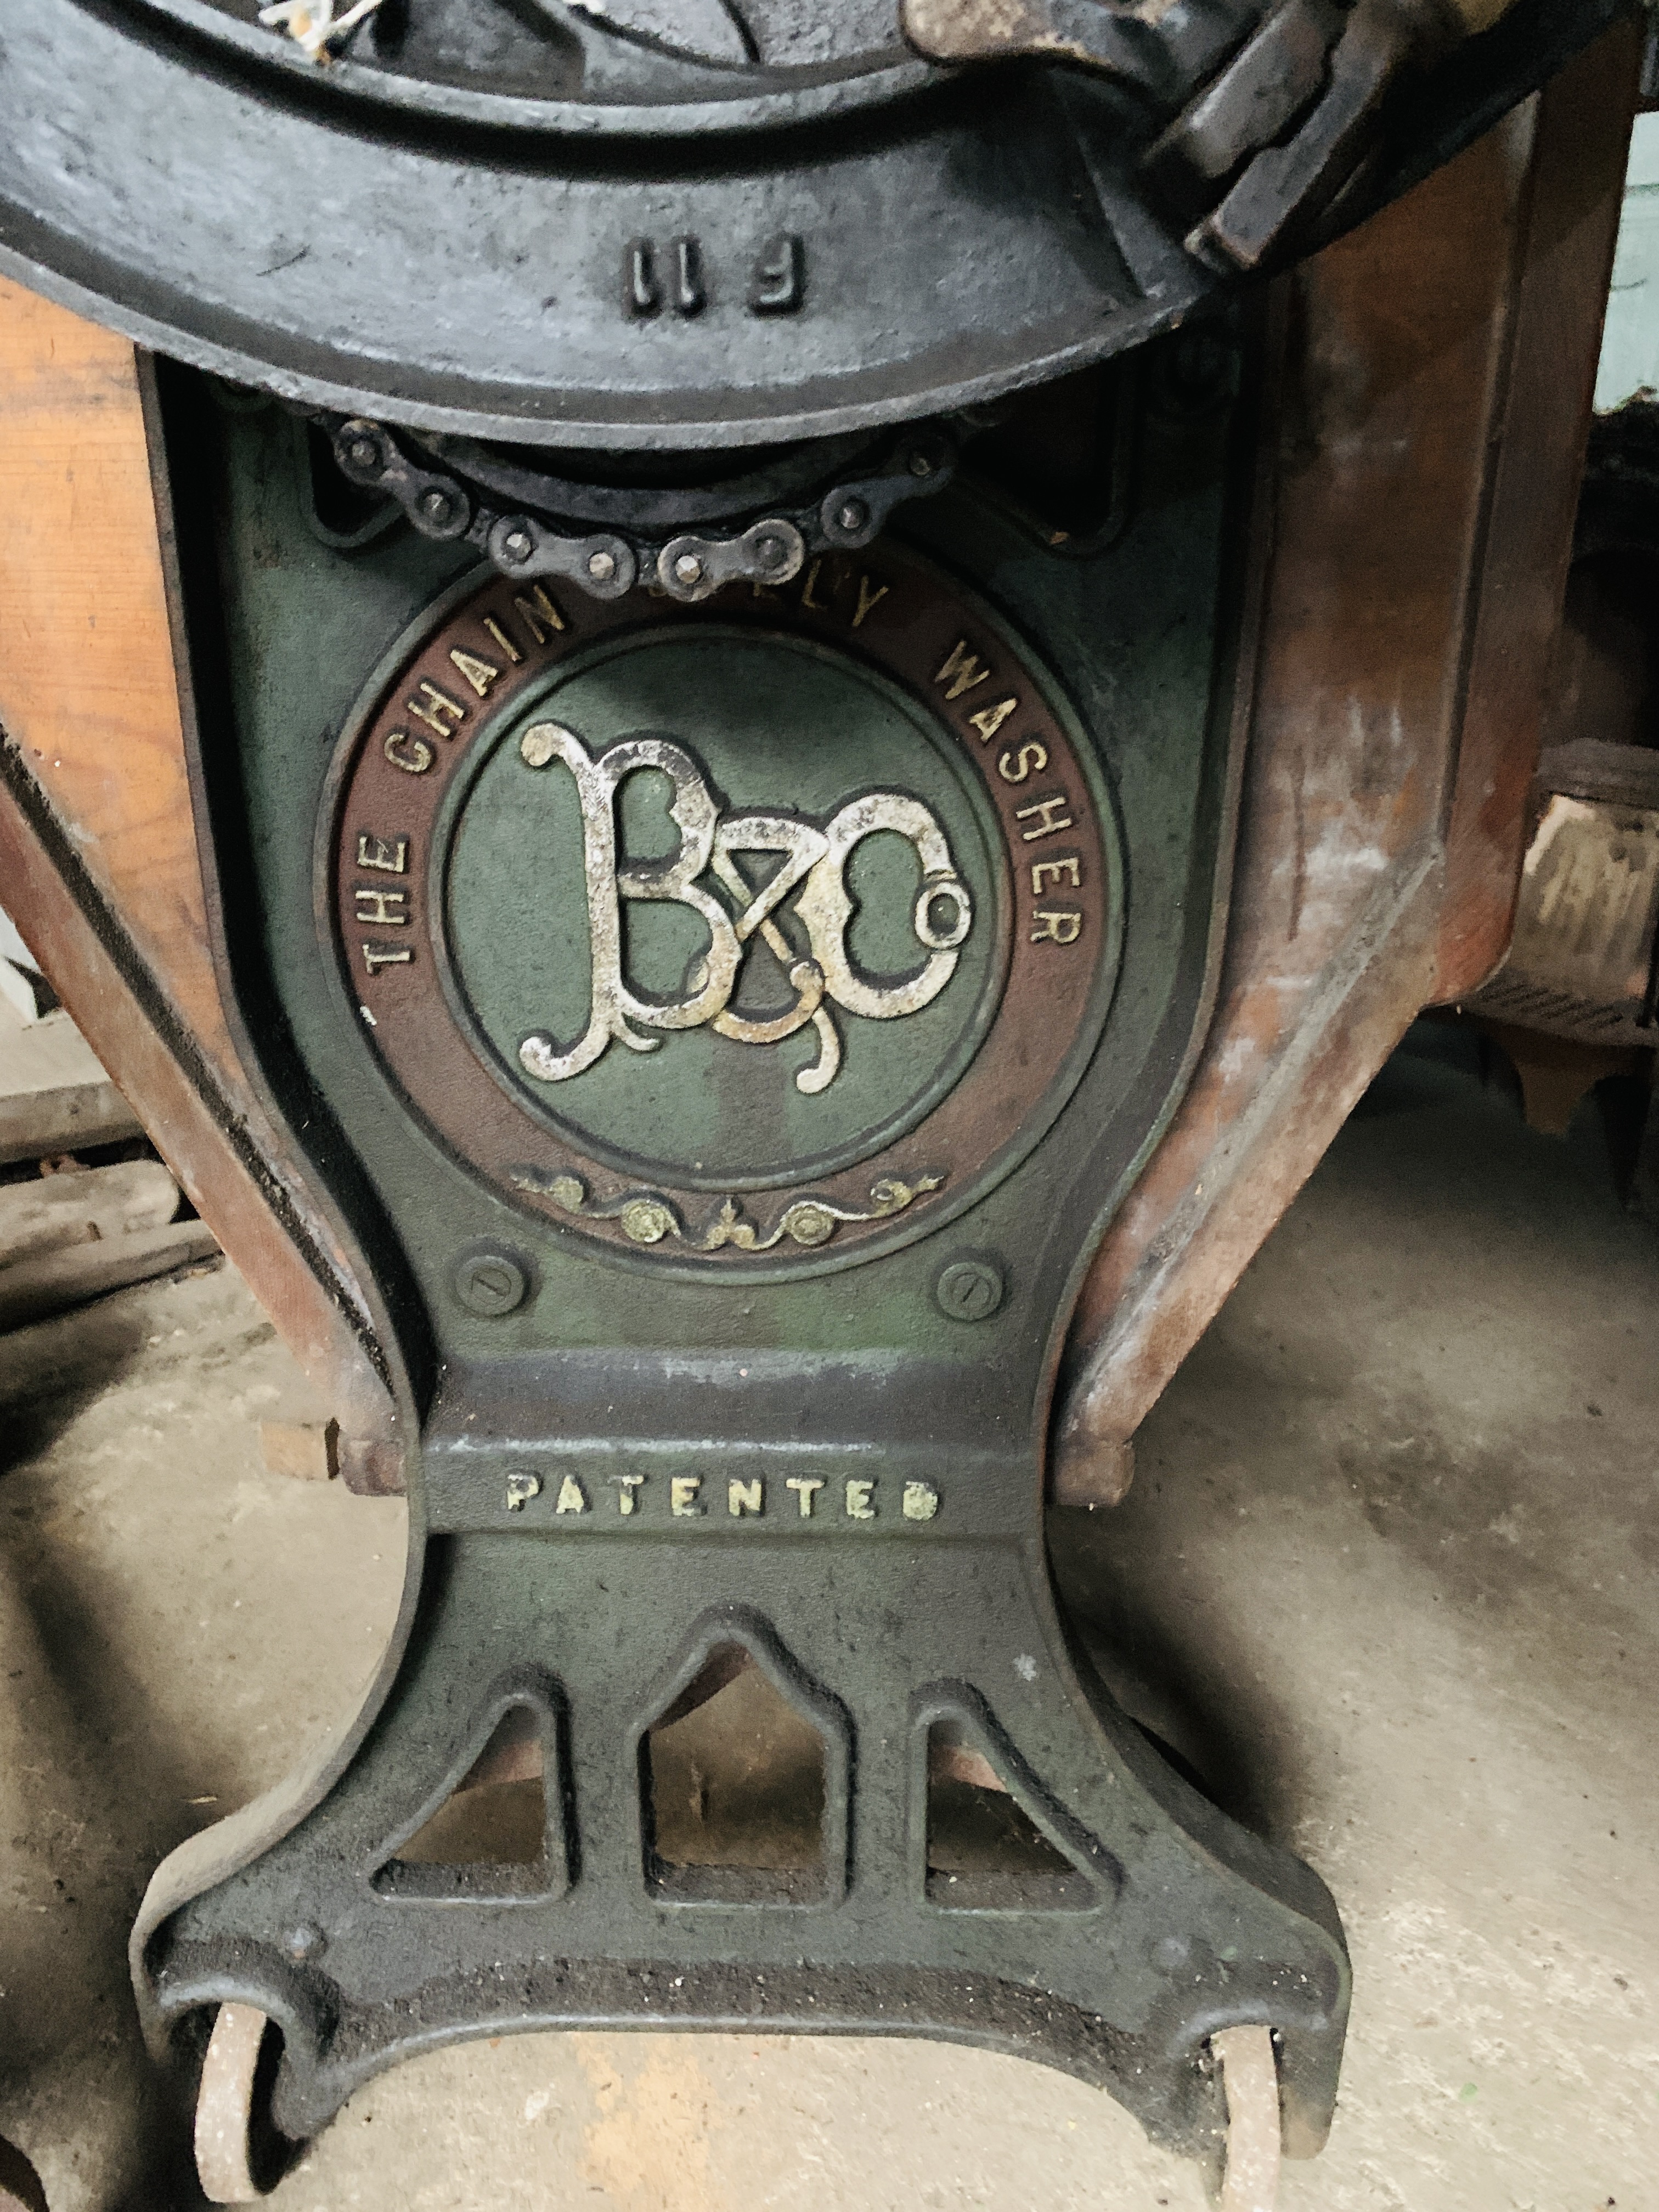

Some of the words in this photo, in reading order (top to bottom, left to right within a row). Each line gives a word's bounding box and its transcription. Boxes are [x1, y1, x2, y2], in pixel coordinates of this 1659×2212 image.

[354, 835, 410, 975] THE
[383, 583, 566, 773] CHAIN
[933, 639, 1082, 945] WASHER
[505, 1474, 940, 1521] PATENTED
